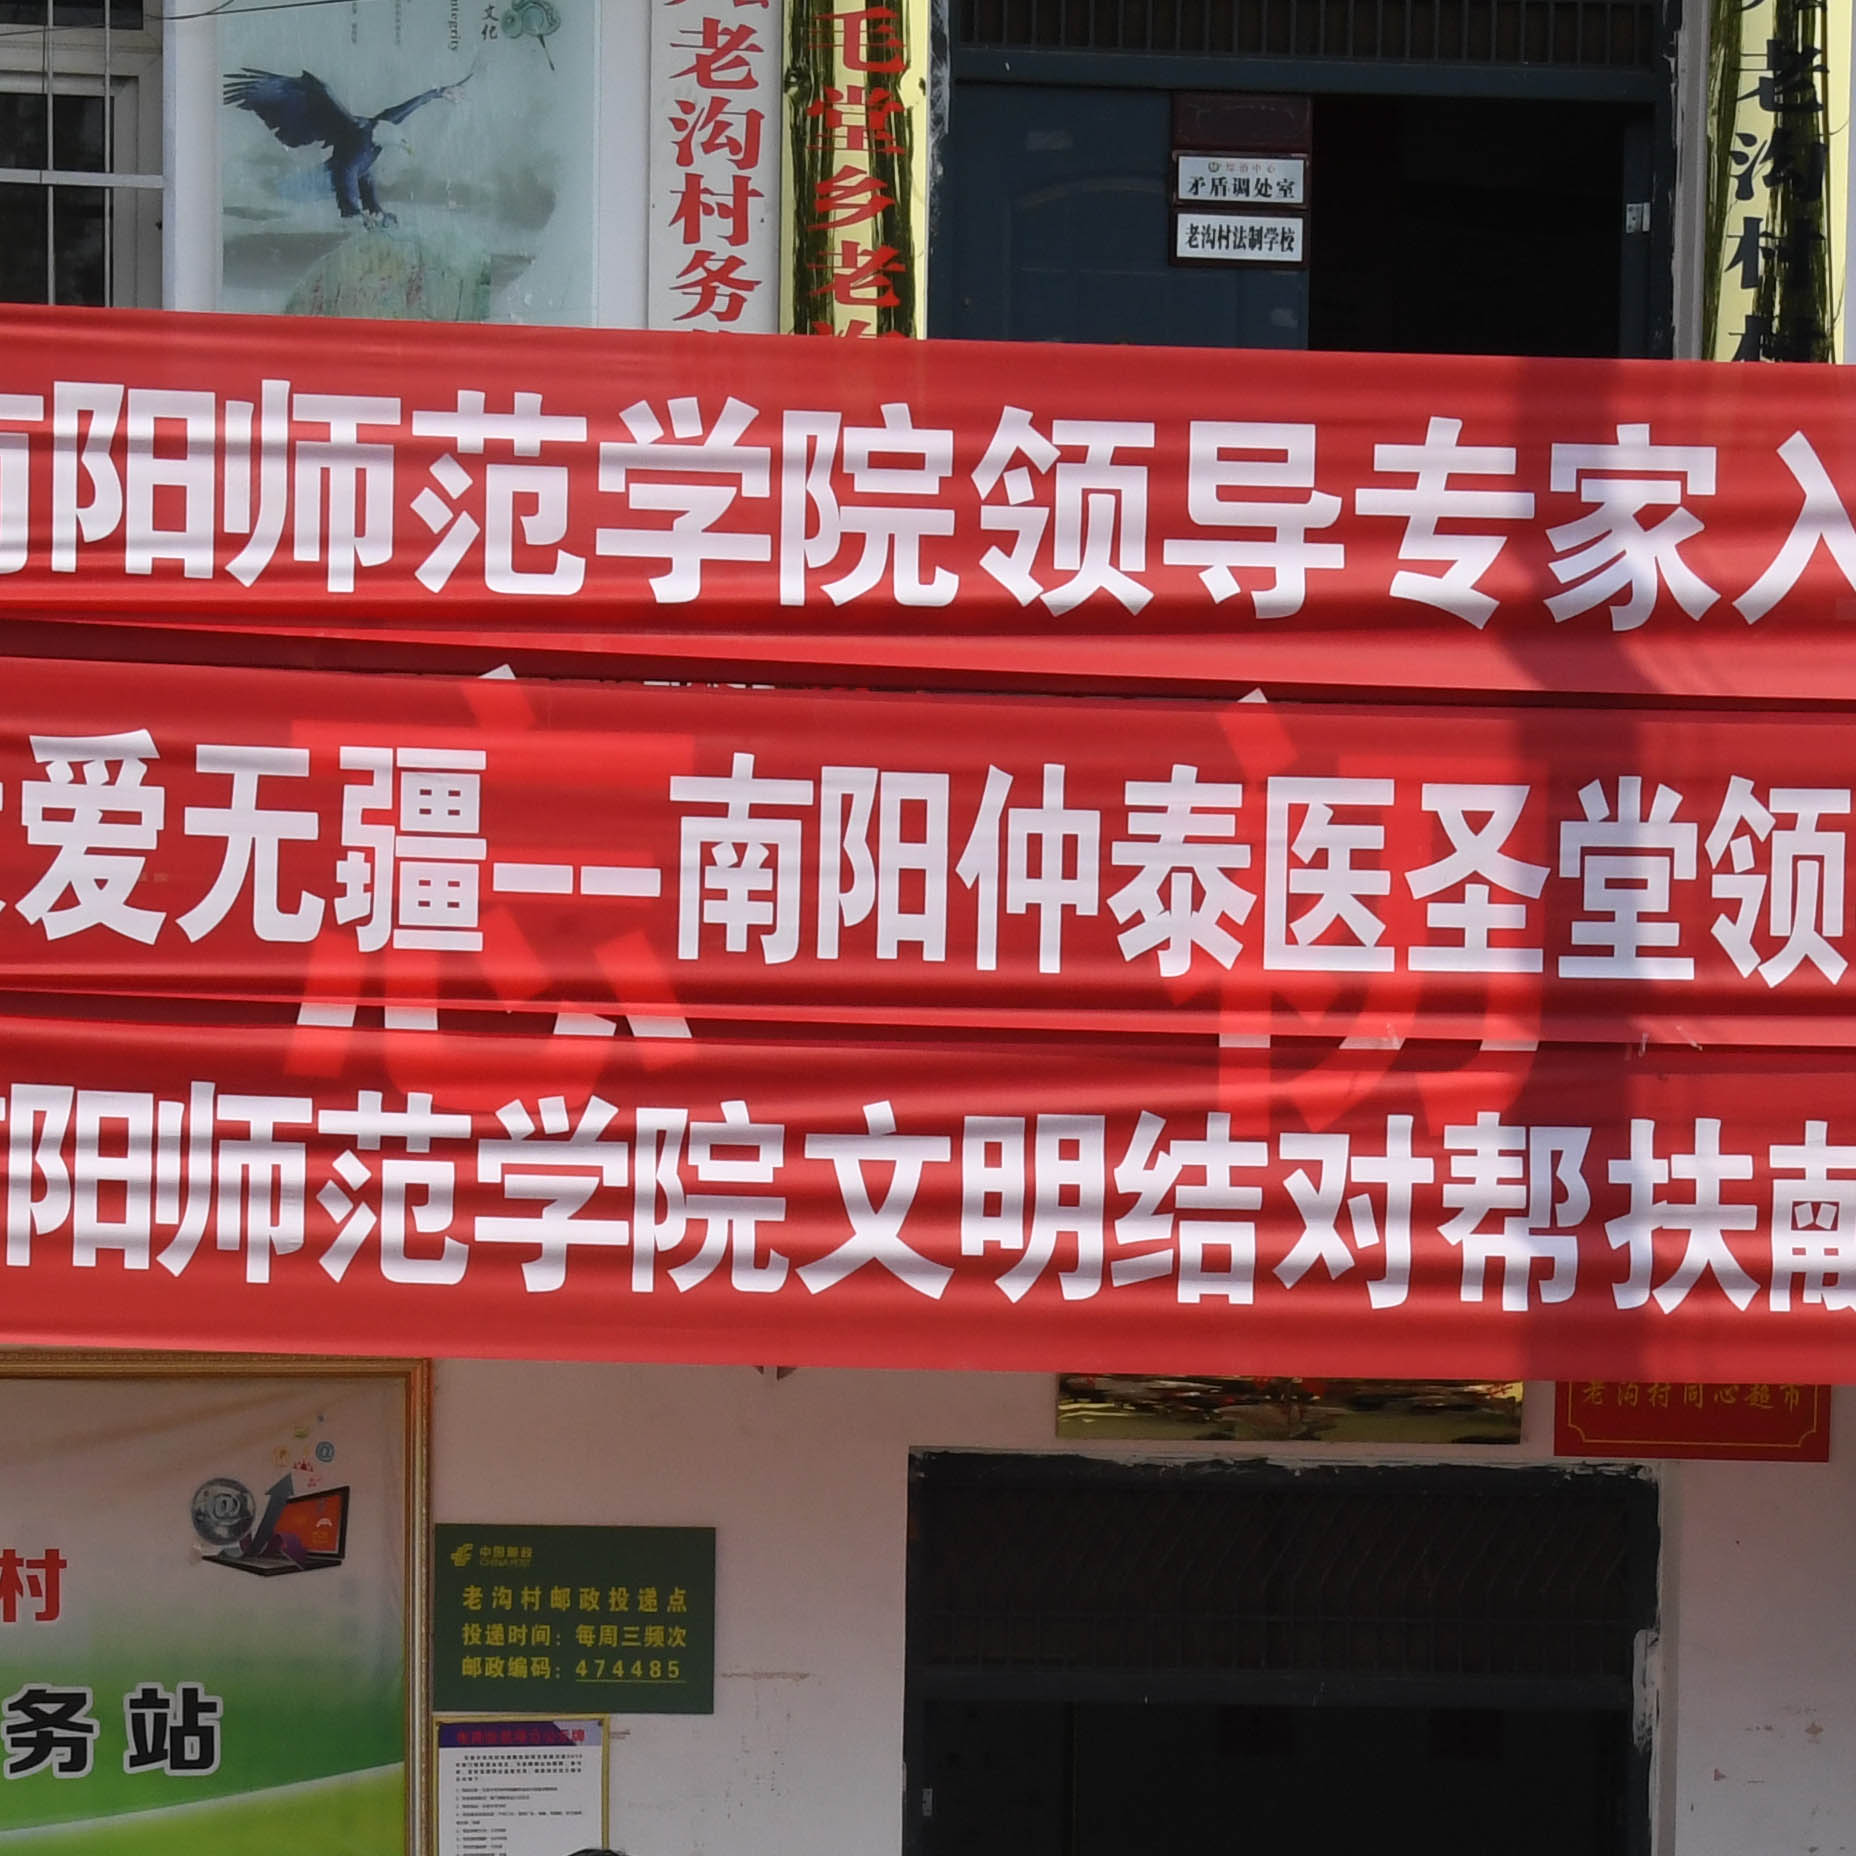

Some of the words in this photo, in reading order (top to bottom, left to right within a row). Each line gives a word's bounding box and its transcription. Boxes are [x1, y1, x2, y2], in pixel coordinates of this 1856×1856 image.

[668, 0, 769, 335] 老沟村务
[806, 6, 908, 337] 毛堂乡老
[1188, 176, 1296, 199] 矛盾调处室
[1185, 223, 1295, 252] 老沟村法制学校
[462, 1584, 687, 1613] 老沟村邮政投递点
